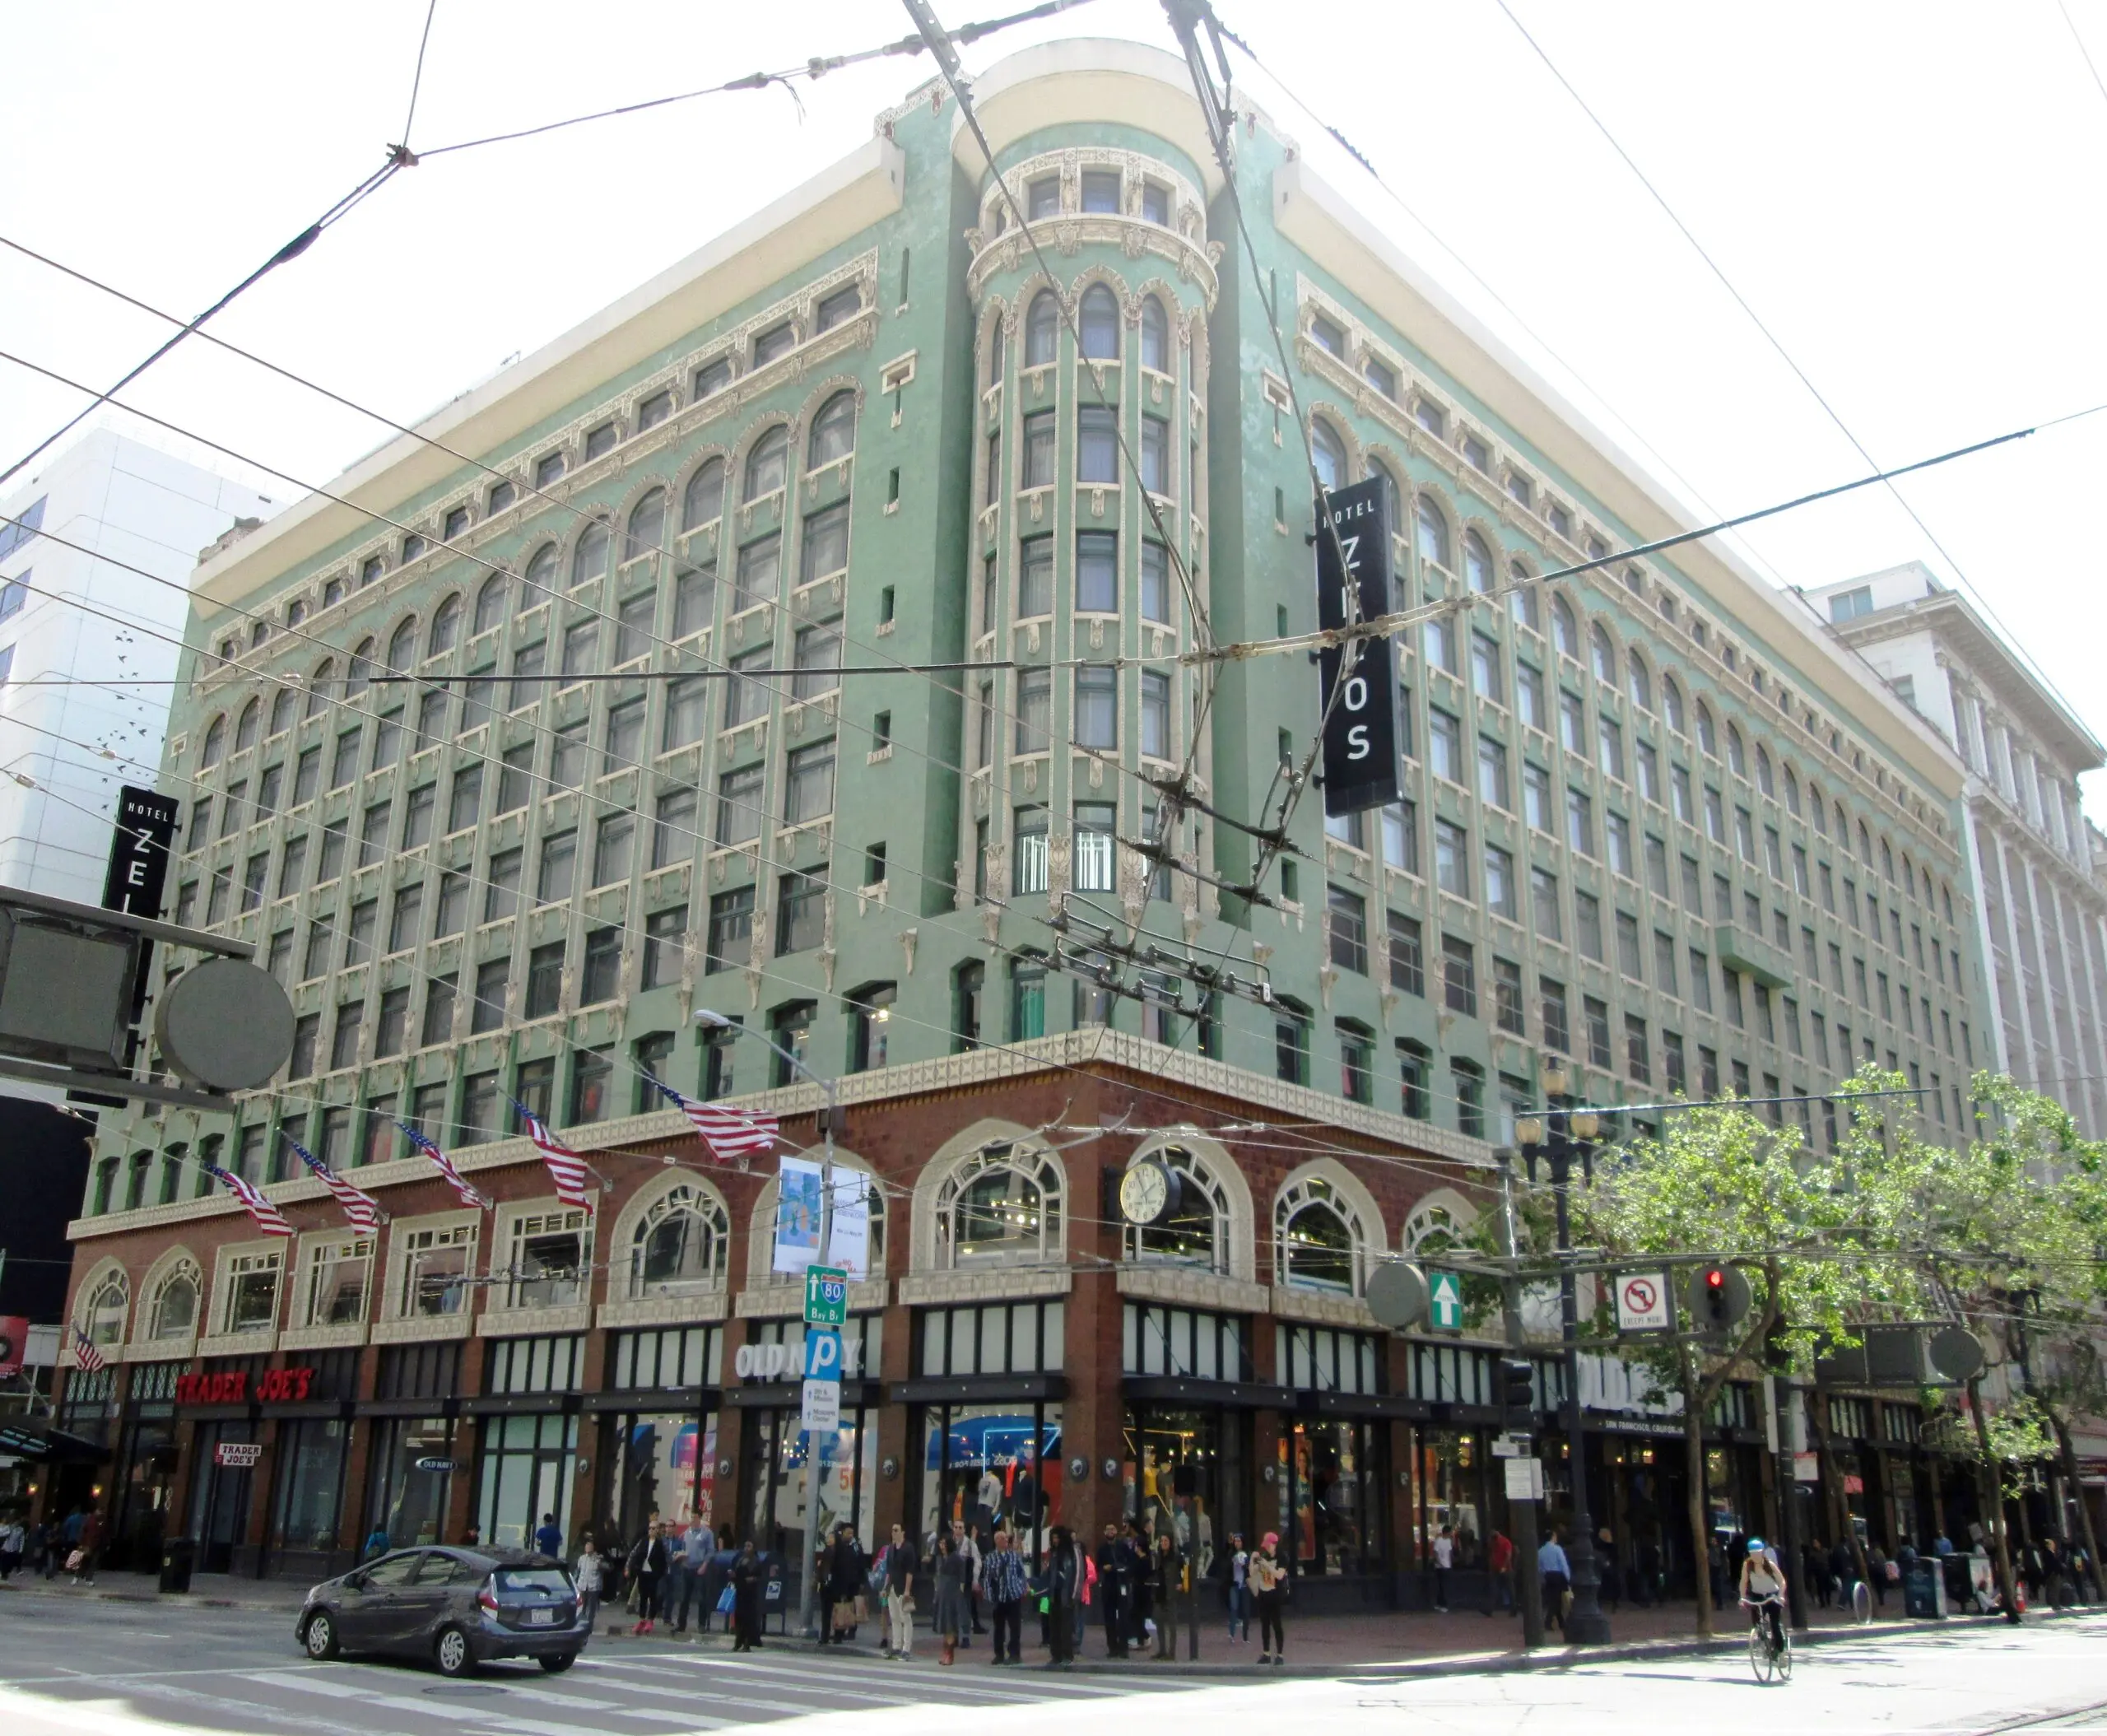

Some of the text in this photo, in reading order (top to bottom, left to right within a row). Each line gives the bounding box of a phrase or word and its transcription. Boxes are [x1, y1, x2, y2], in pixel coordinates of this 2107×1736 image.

[1341, 536, 1370, 760] ZEOS
[128, 802, 169, 822] HOTEL
[825, 1283, 841, 1299] 80
[812, 1307, 839, 1321] Bay Br
[735, 1338, 863, 1378] OLD NY
[809, 1335, 837, 1375] P
[175, 1369, 315, 1403] TRADER JOE'S
[1605, 1420, 1617, 1429] SAN
[222, 1446, 261, 1455] TRADER
[226, 1455, 253, 1464] JOE'S
[424, 1460, 436, 1468] OLD
